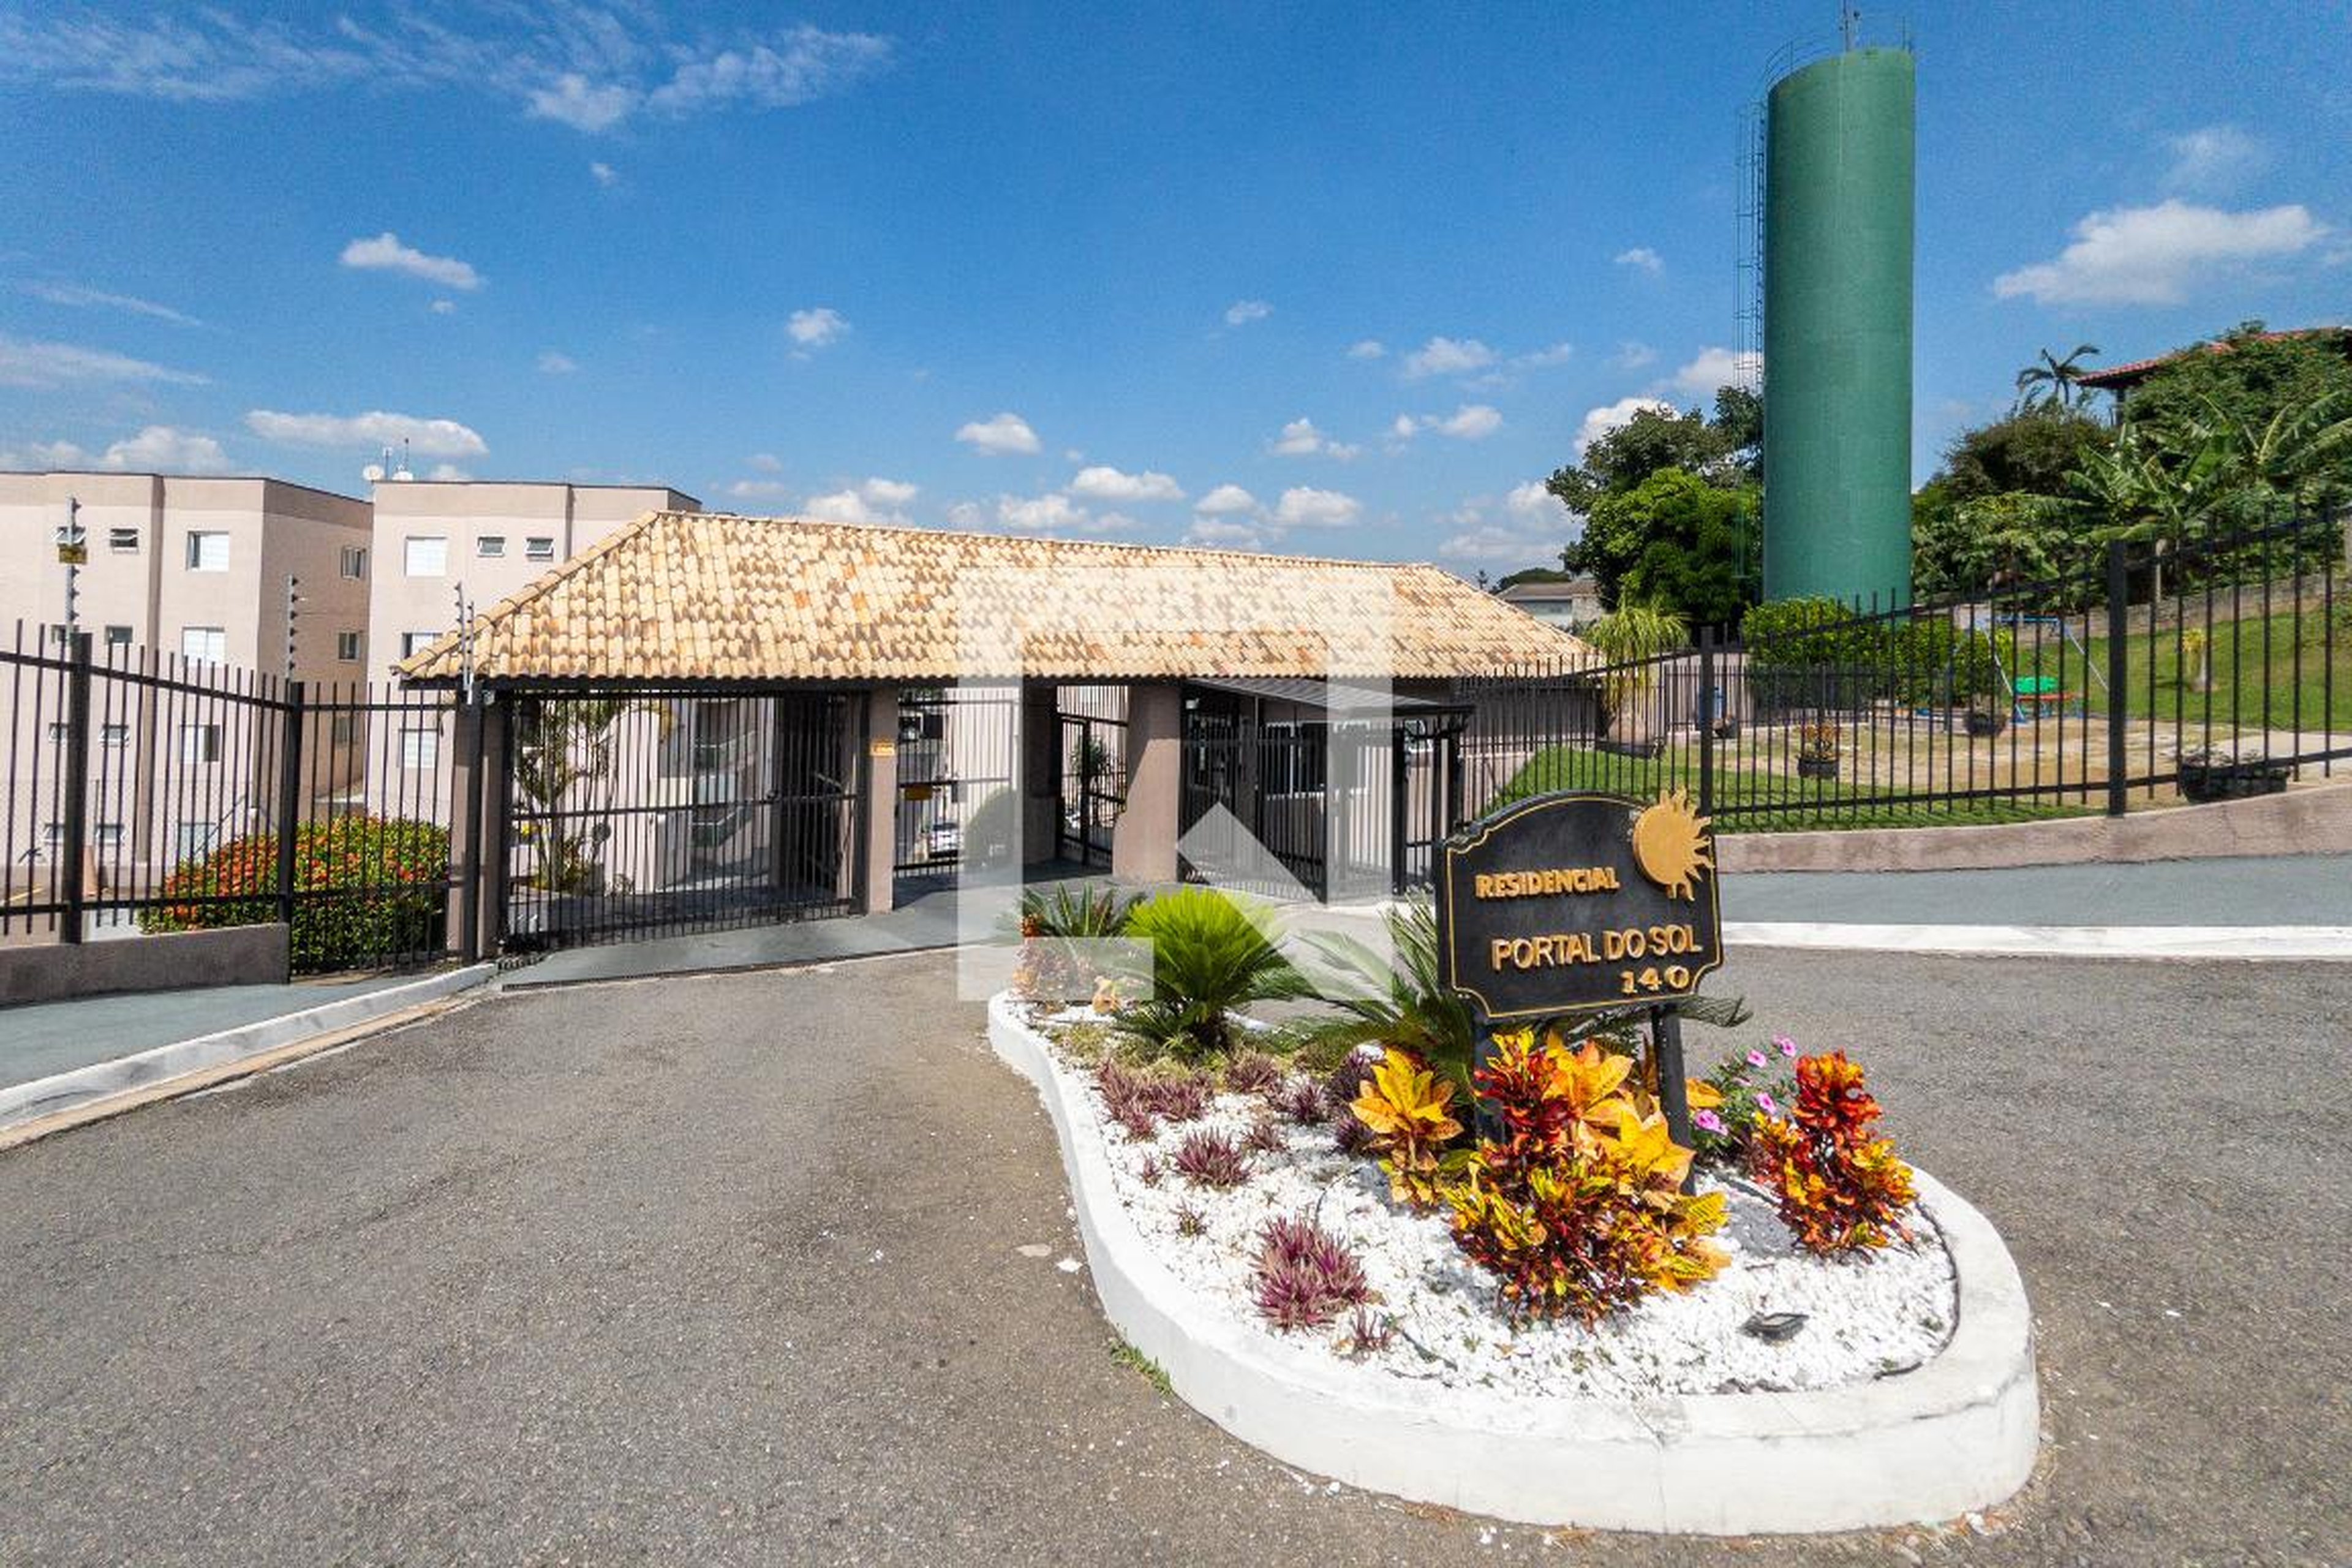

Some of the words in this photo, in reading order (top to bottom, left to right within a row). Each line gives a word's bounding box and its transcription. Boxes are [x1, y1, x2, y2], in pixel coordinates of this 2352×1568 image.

[1475, 867, 1621, 899] RESIDENCIAL
[1491, 932, 1601, 971] PORTAL
[1602, 927, 1646, 960] DO
[1648, 924, 1703, 956] SOL
[1621, 965, 1690, 994] 140
